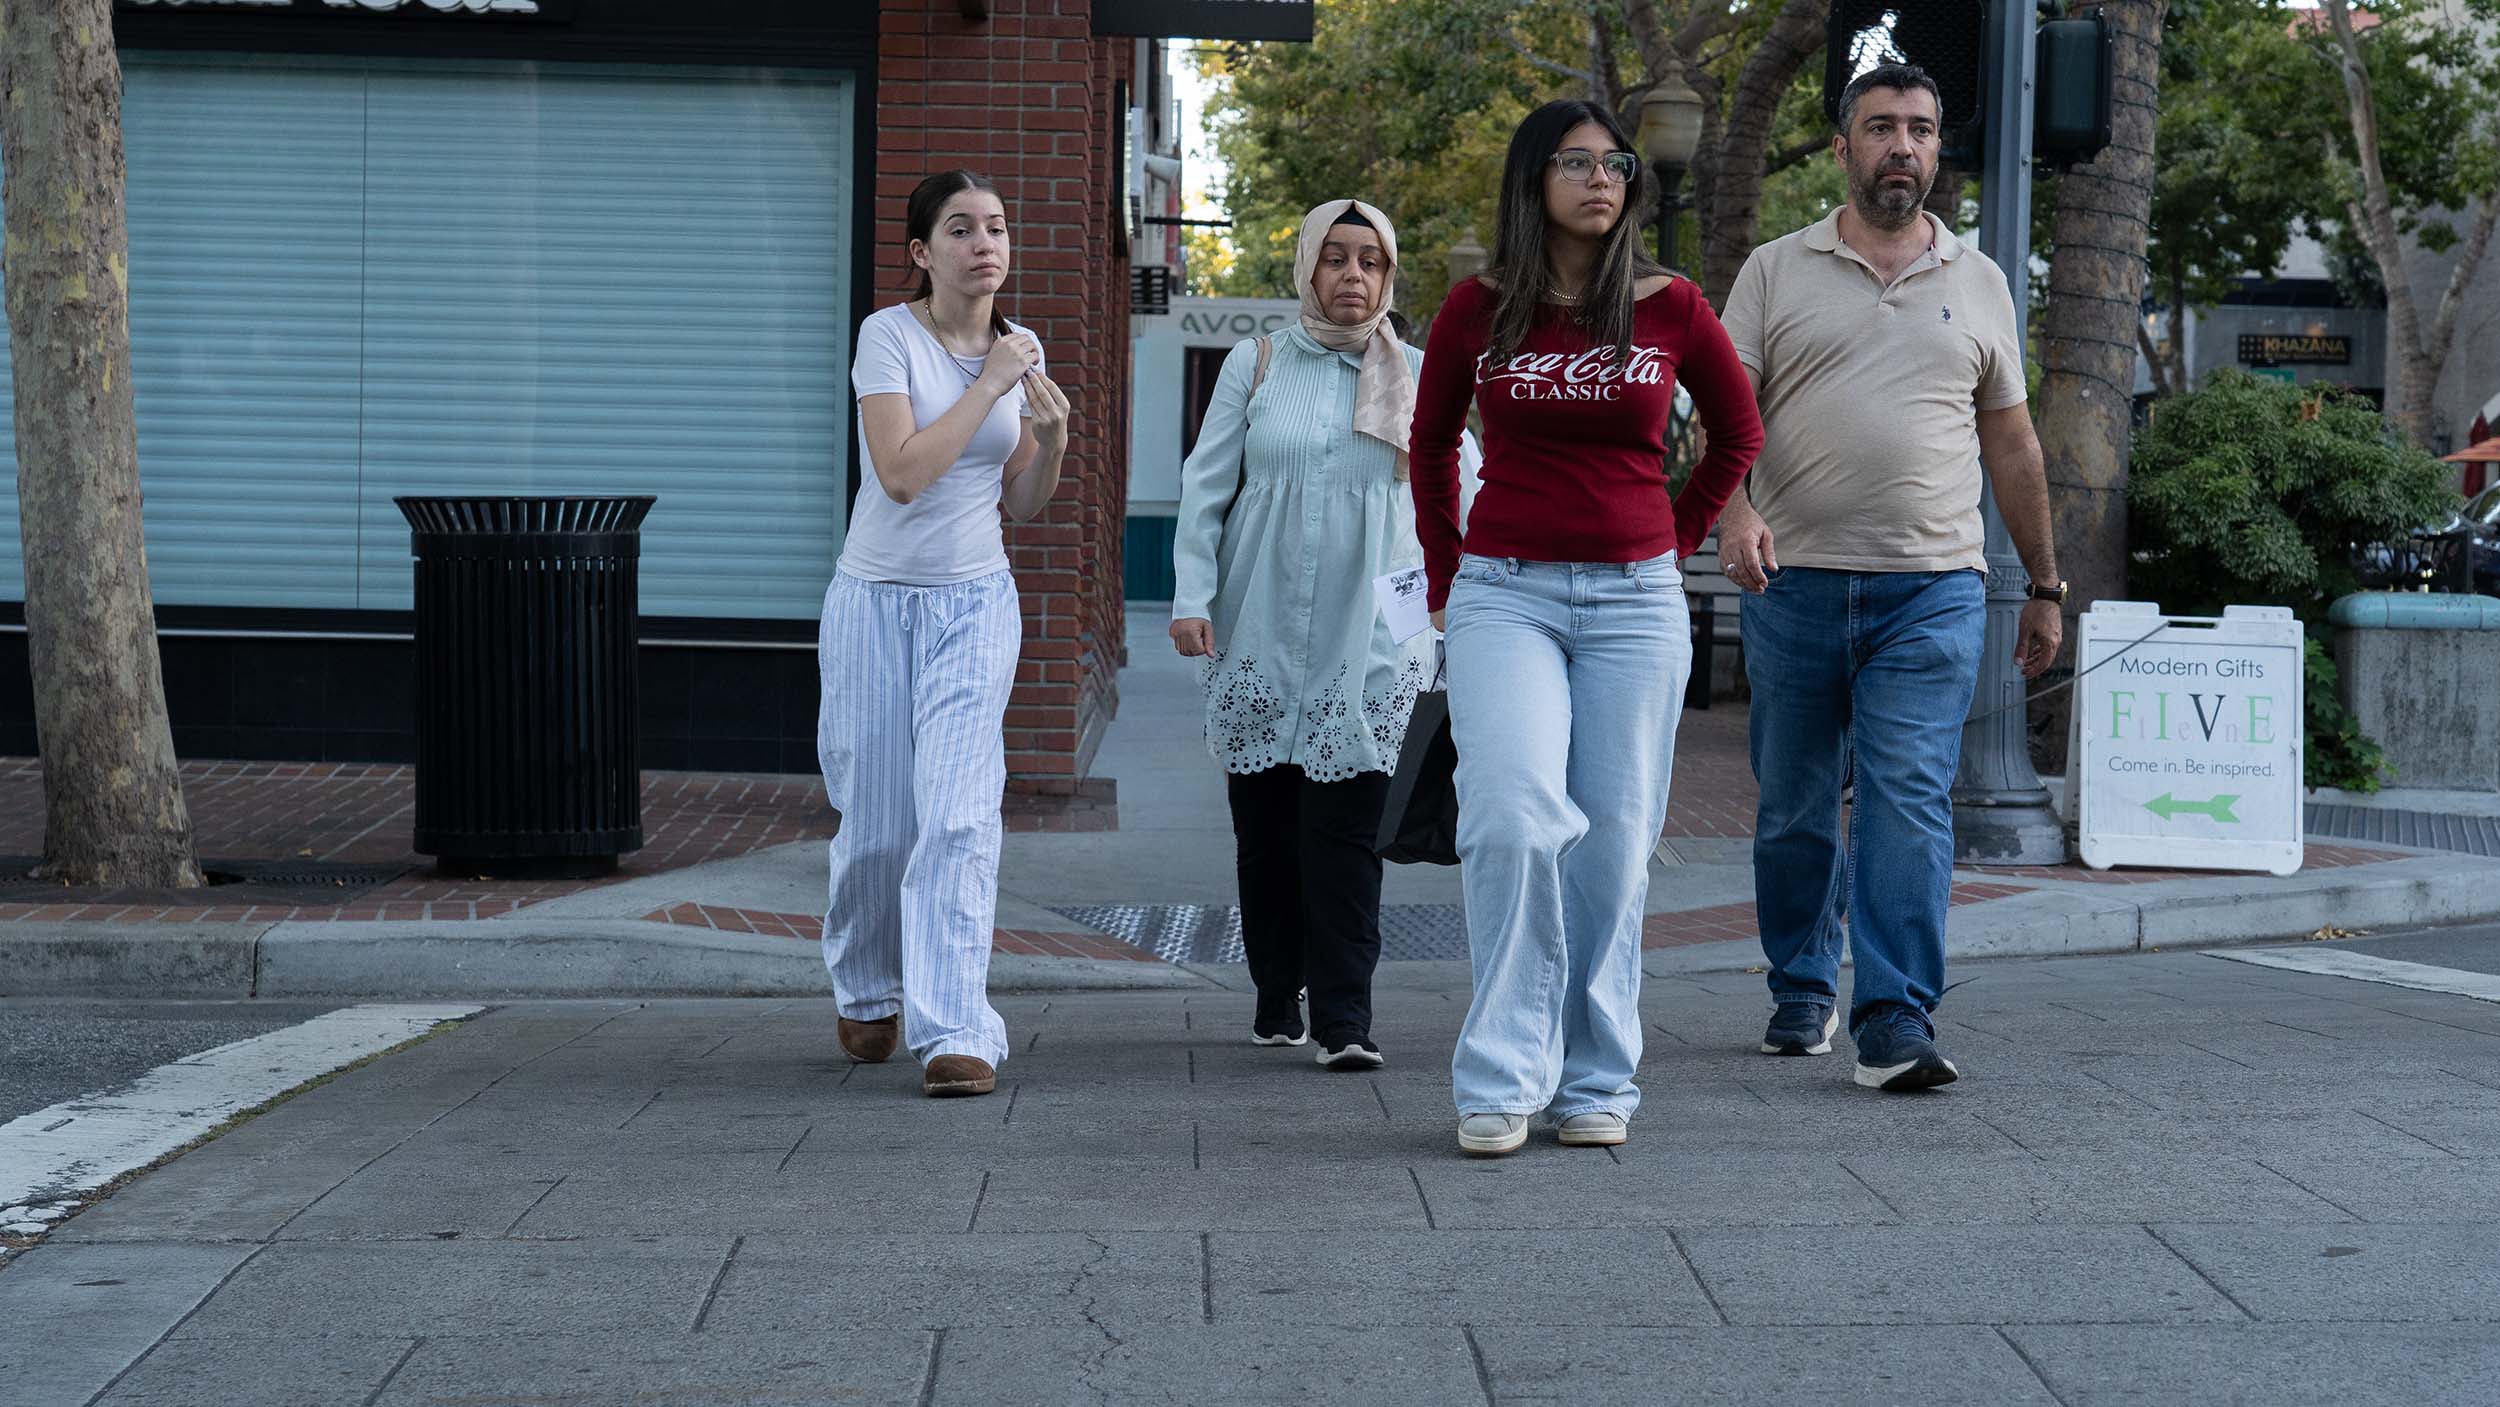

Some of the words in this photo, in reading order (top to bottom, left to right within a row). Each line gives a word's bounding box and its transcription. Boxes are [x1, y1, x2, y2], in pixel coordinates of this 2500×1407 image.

[1475, 344, 1670, 385] ca-Cola
[1510, 383, 1621, 401] CLASSIC
[2119, 657, 2208, 676] Modern
[2215, 659, 2264, 678] Gifts
[2108, 756, 2158, 773] Come
[2164, 758, 2181, 774] in.
[2185, 759, 2205, 774] Be
[2211, 760, 2275, 779] inspired.
